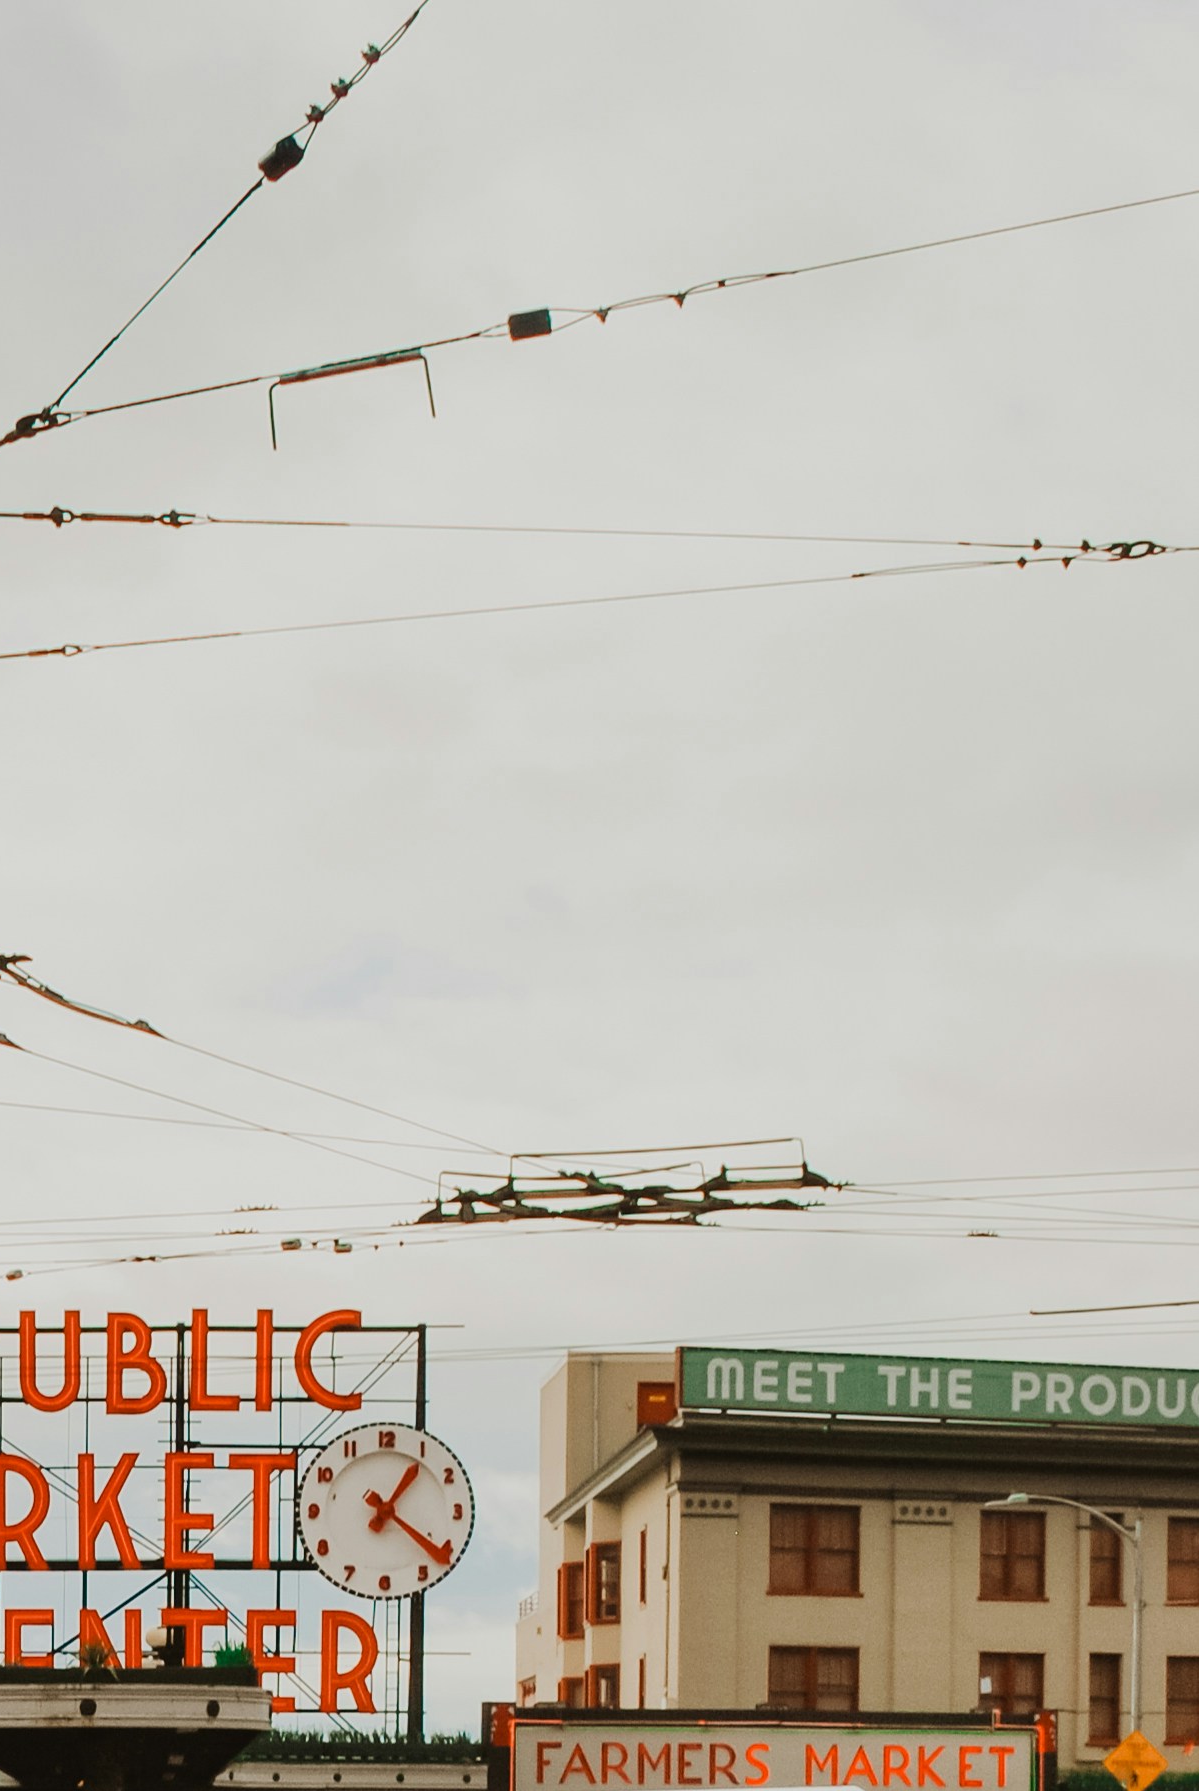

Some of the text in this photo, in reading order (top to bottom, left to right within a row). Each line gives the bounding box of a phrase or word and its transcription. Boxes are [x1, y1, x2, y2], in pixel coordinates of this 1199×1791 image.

[706, 1357, 1199, 1419] MEET THE PRODU
[379, 1431, 396, 1448] 12
[344, 1440, 357, 1458] 11
[317, 1467, 333, 1483] 10
[444, 1468, 454, 1484] 2
[308, 1503, 320, 1519] 9
[453, 1503, 463, 1520] 3
[317, 1539, 329, 1556] 8
[344, 1565, 355, 1582] 7
[418, 1565, 428, 1581] 5
[379, 1575, 391, 1591] 6
[535, 1742, 1015, 1788] FARMERS MARKET
